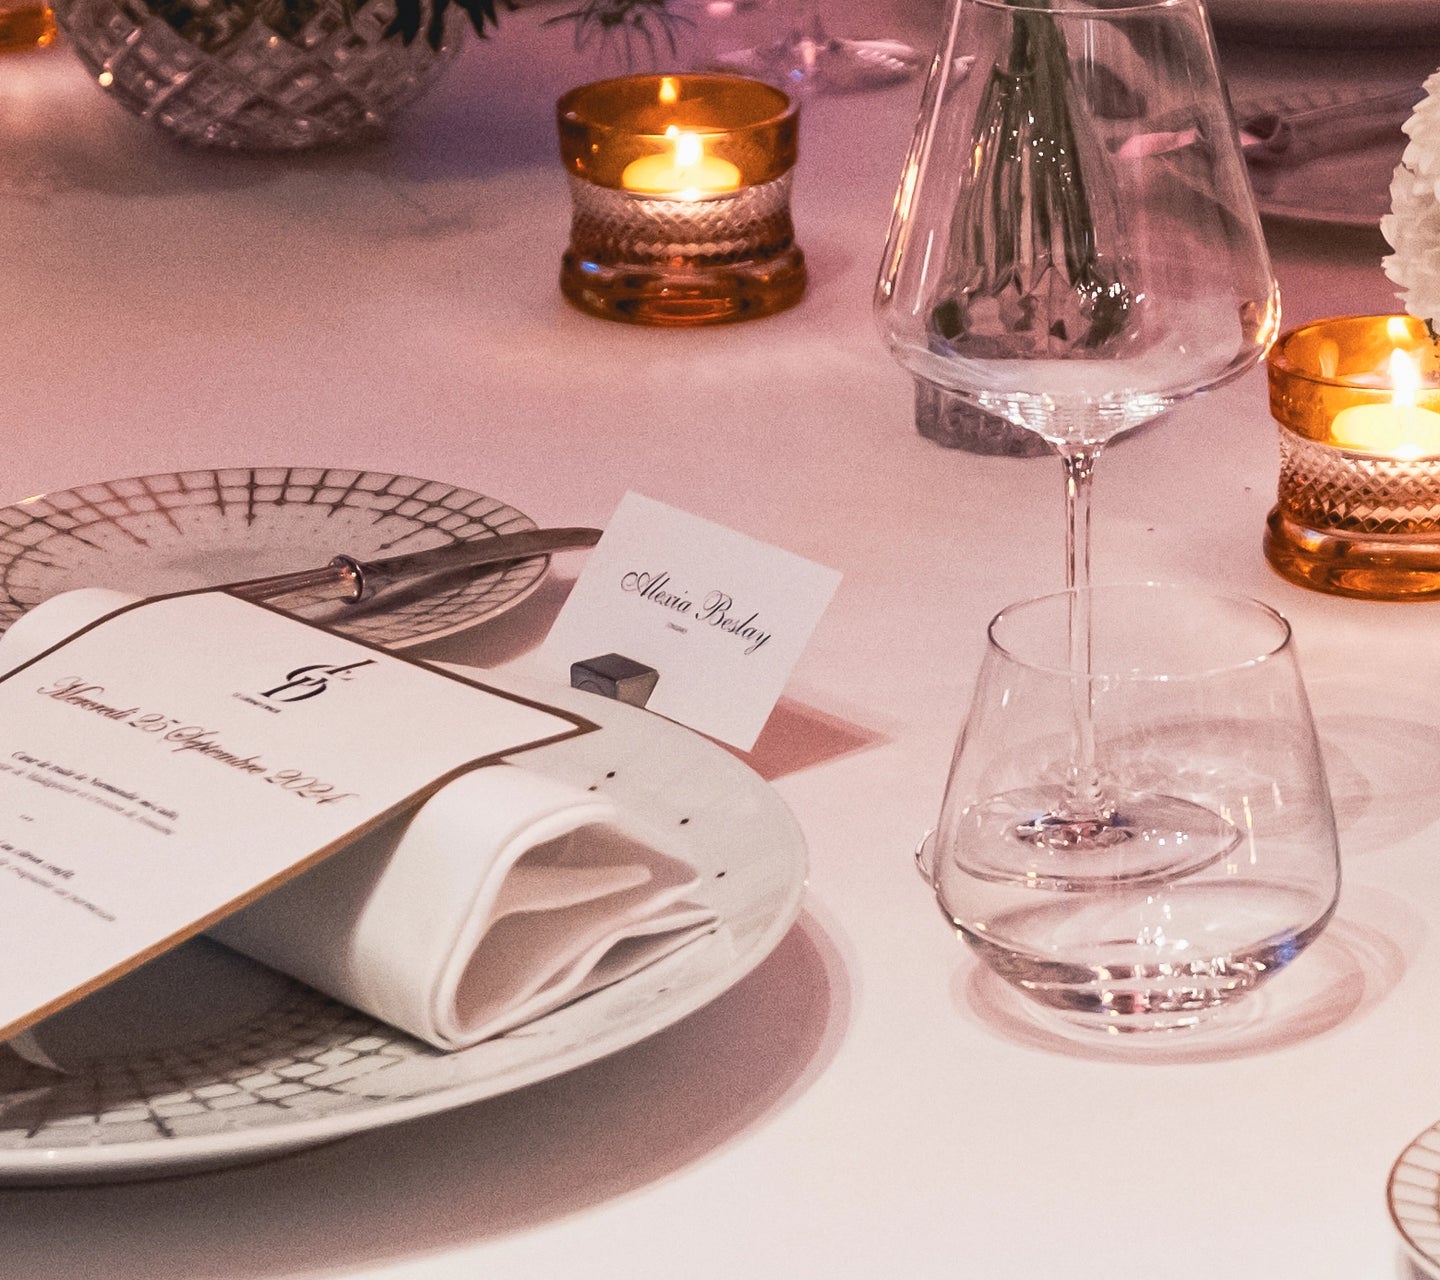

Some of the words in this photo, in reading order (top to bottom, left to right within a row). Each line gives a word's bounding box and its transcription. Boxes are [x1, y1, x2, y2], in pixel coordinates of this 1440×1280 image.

[620, 571, 692, 614] Alexia
[695, 589, 771, 655] Beslay
[37, 675, 137, 721] Mercredi
[128, 712, 179, 733] 25
[163, 725, 266, 775] Septembre
[264, 768, 360, 805] 2024
